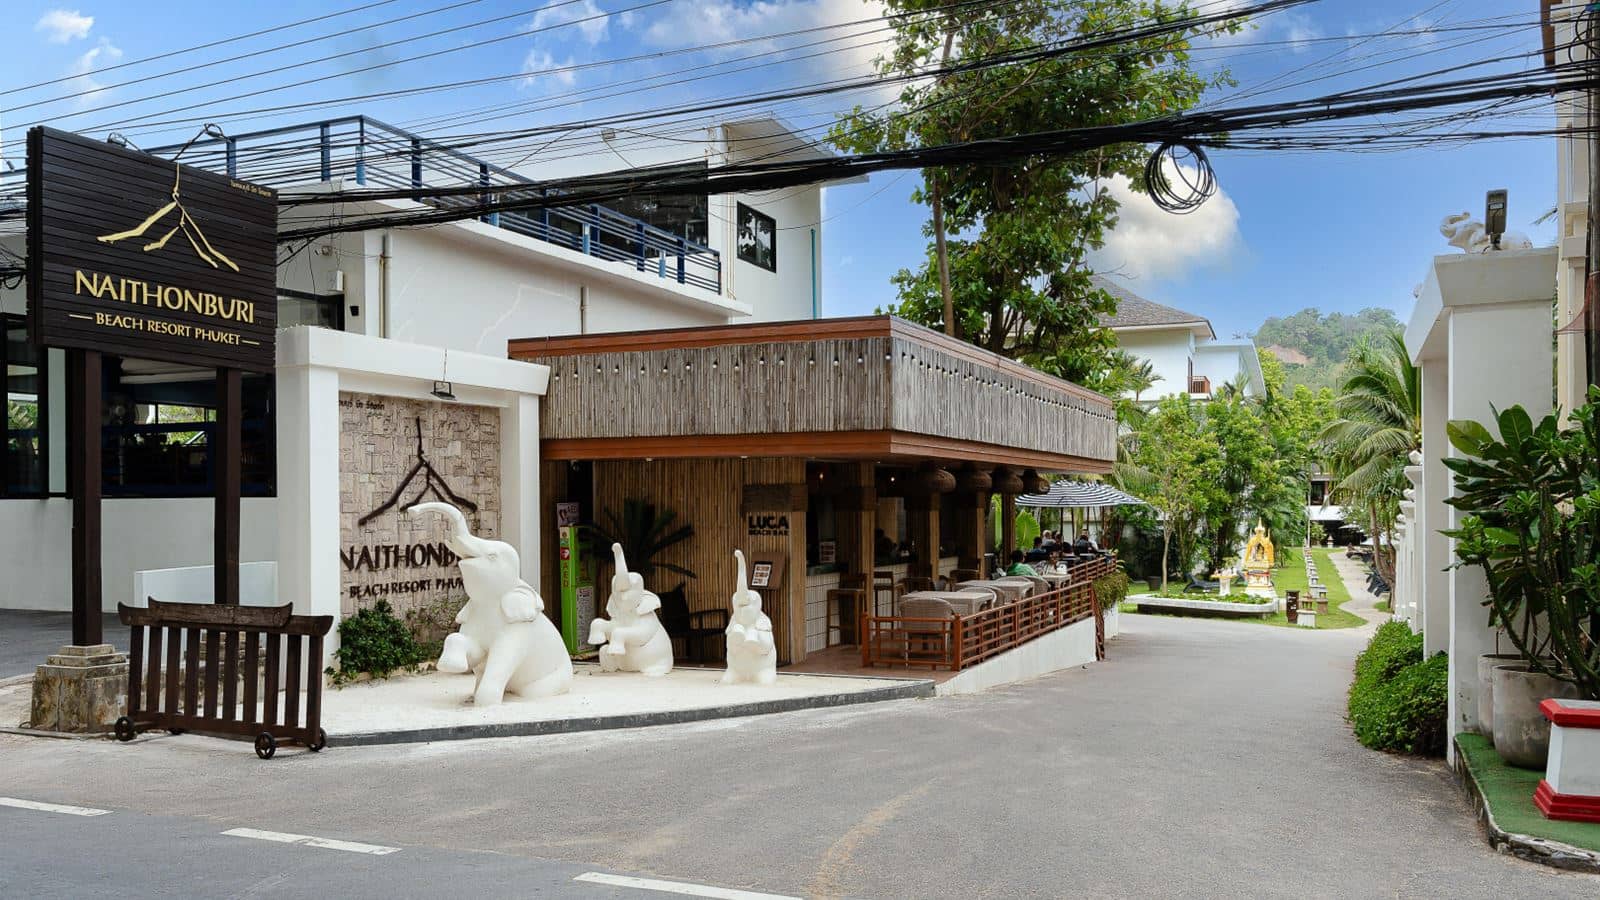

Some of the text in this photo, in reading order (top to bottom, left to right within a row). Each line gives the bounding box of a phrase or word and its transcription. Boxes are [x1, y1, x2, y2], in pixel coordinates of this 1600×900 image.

[75, 269, 255, 324] NAITHONBURI
[96, 312, 240, 346] BEACH RESORT PHUKET
[748, 515, 789, 529] LUCA
[339, 542, 463, 571] NAITHONB
[349, 577, 465, 599] BEACH RESORT PHUK
